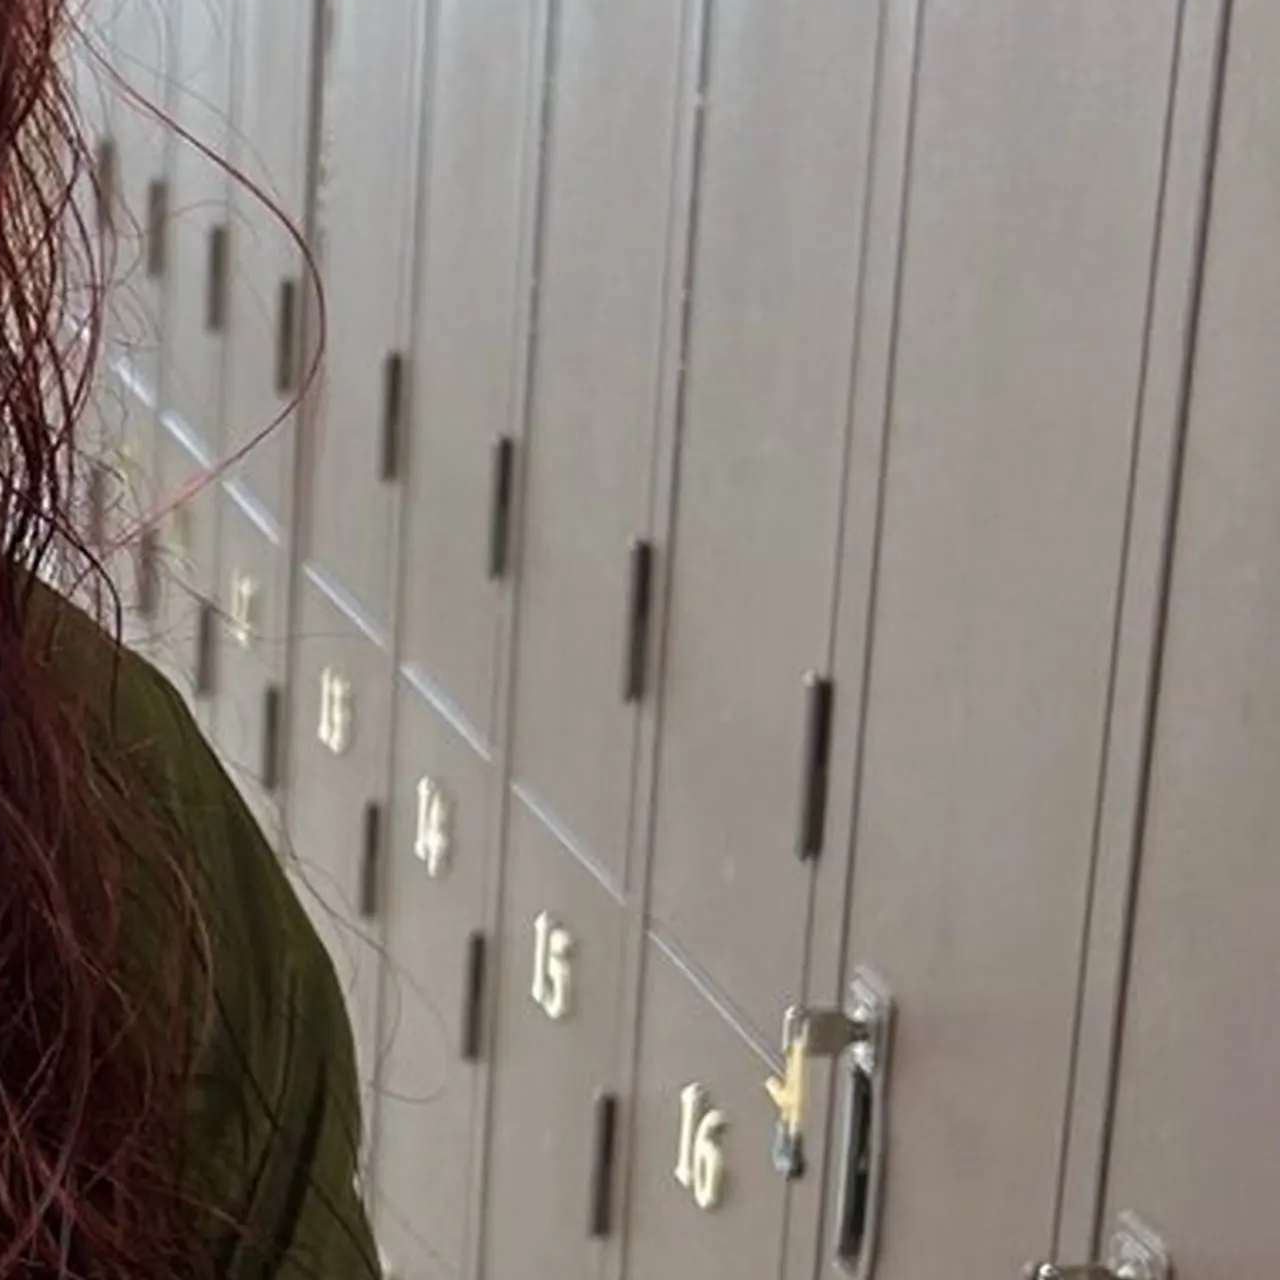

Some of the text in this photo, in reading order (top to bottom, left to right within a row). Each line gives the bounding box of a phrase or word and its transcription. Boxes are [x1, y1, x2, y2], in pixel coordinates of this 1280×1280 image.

[414, 776, 446, 877] 14
[531, 910, 570, 1019] 15
[674, 1082, 724, 1208] 16
